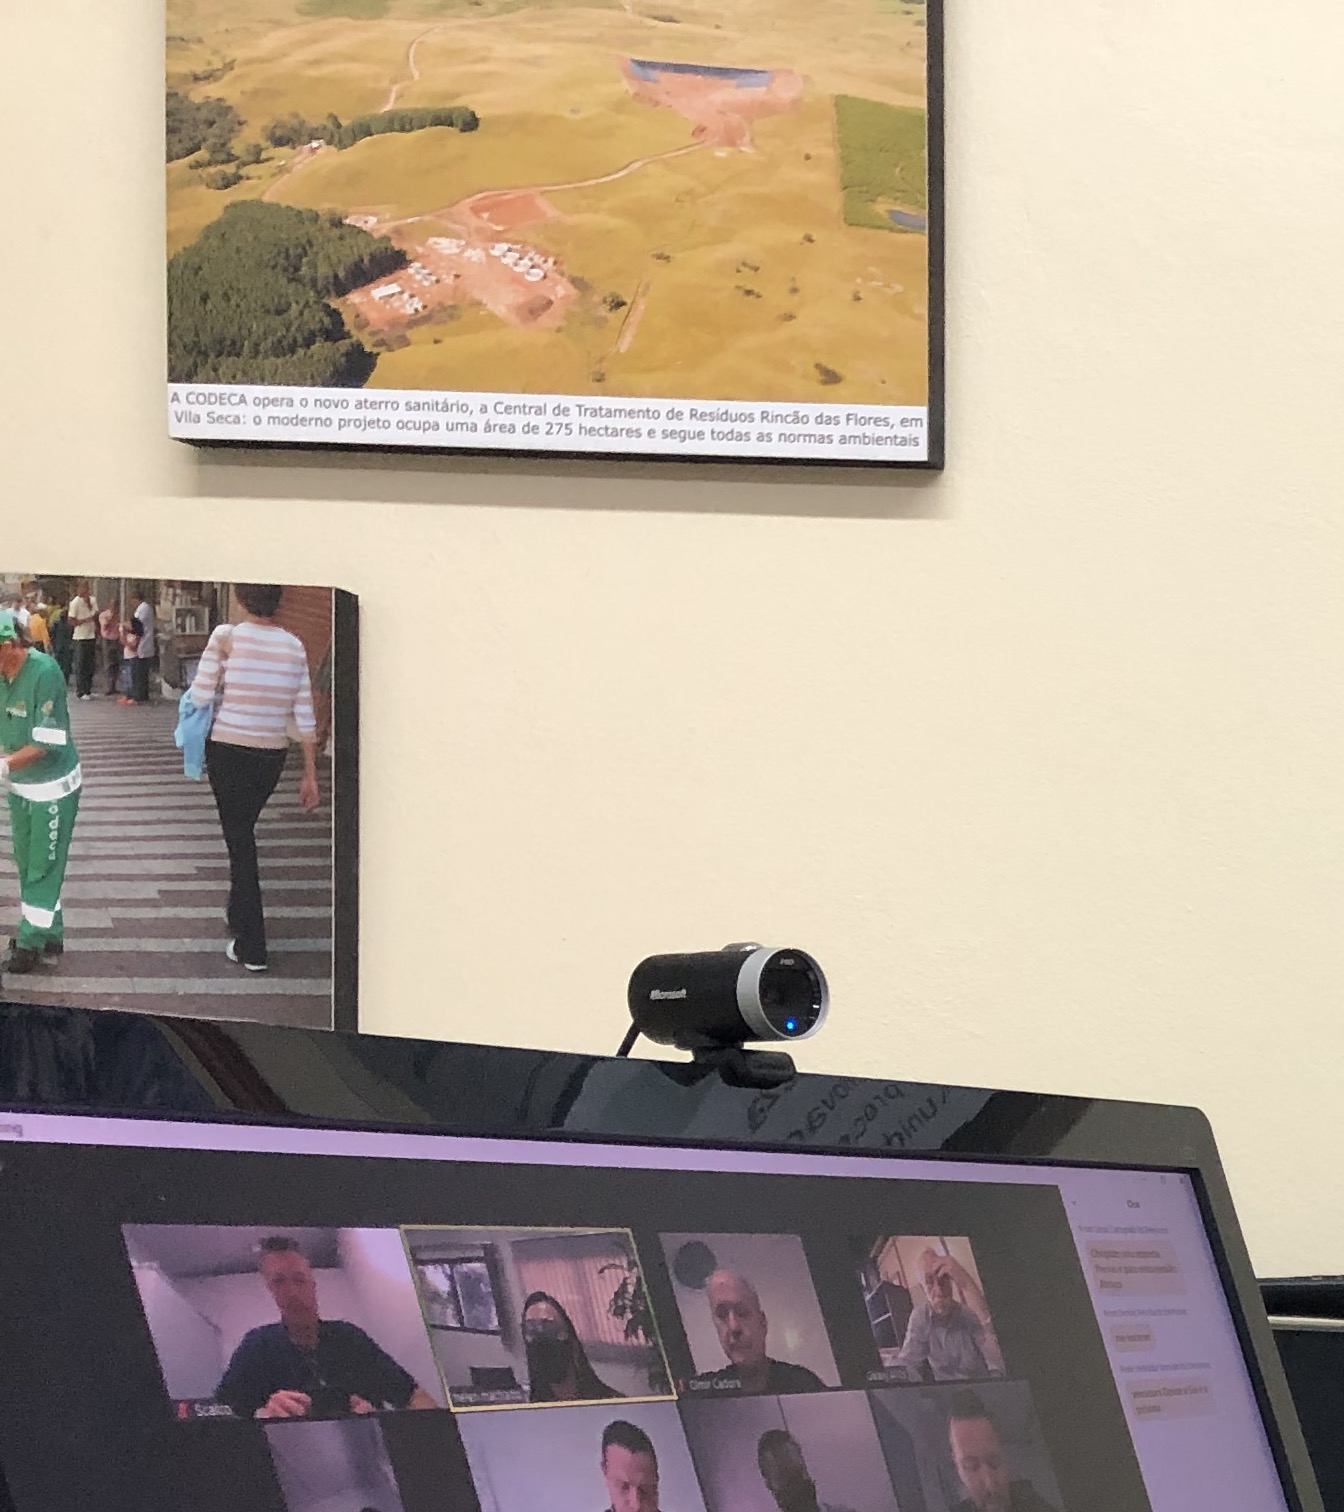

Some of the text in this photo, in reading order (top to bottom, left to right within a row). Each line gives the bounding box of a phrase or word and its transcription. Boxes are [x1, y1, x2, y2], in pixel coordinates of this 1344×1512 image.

[170, 392, 923, 429] A CODECA opera o novo aterro sanitário, a Central de Tratamento de Resíduos Rincão das Flores, em
[174, 411, 920, 449] Vila Seca: o moderno projeto ocupa uma área de 275 hectares e segue todas as normas ambientais
